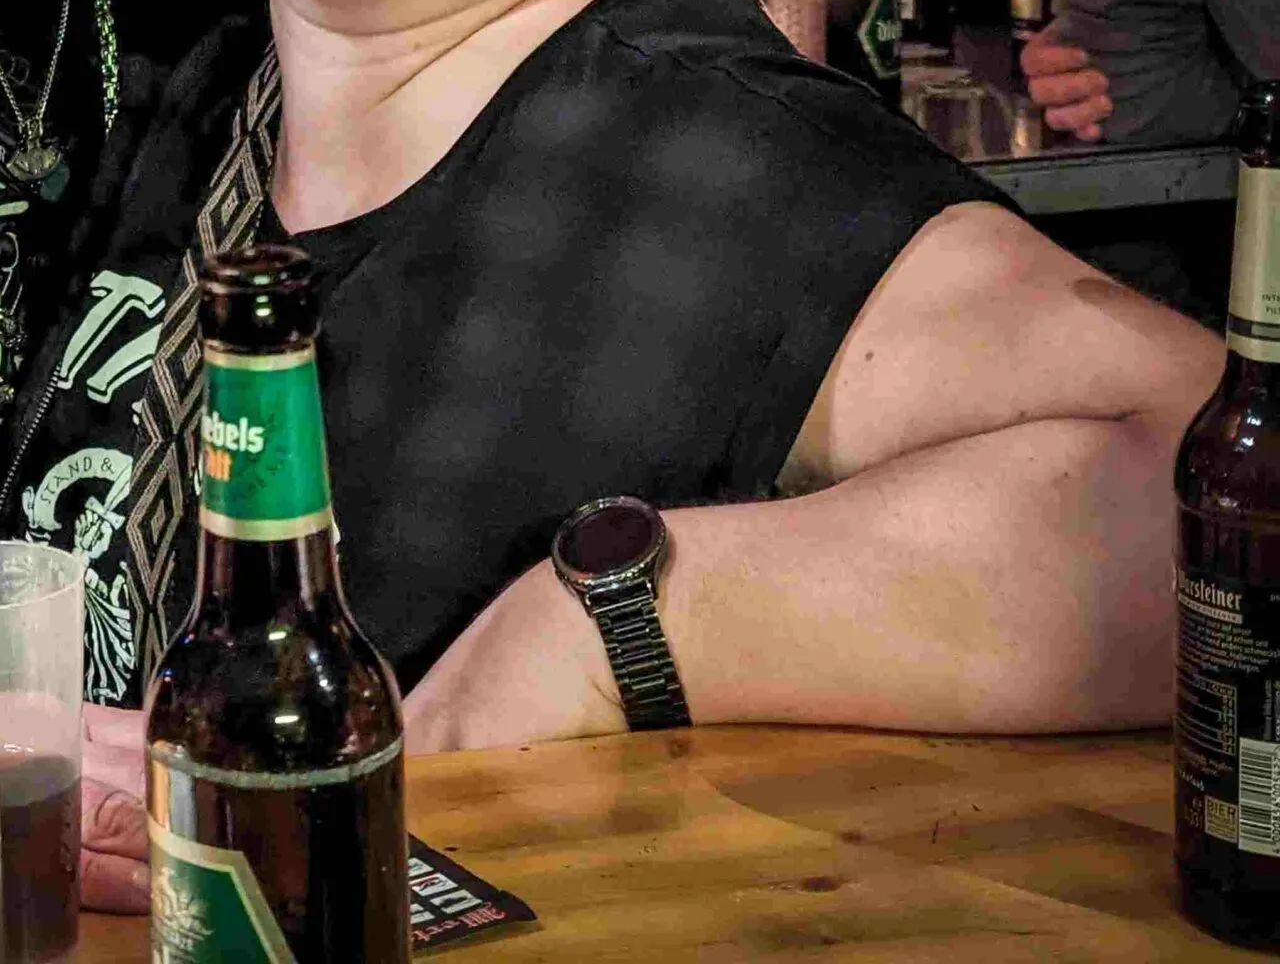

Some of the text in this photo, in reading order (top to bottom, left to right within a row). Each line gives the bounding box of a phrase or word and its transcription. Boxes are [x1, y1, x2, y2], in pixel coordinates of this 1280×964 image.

[202, 411, 265, 455] ebels
[41, 456, 115, 504] STAND &
